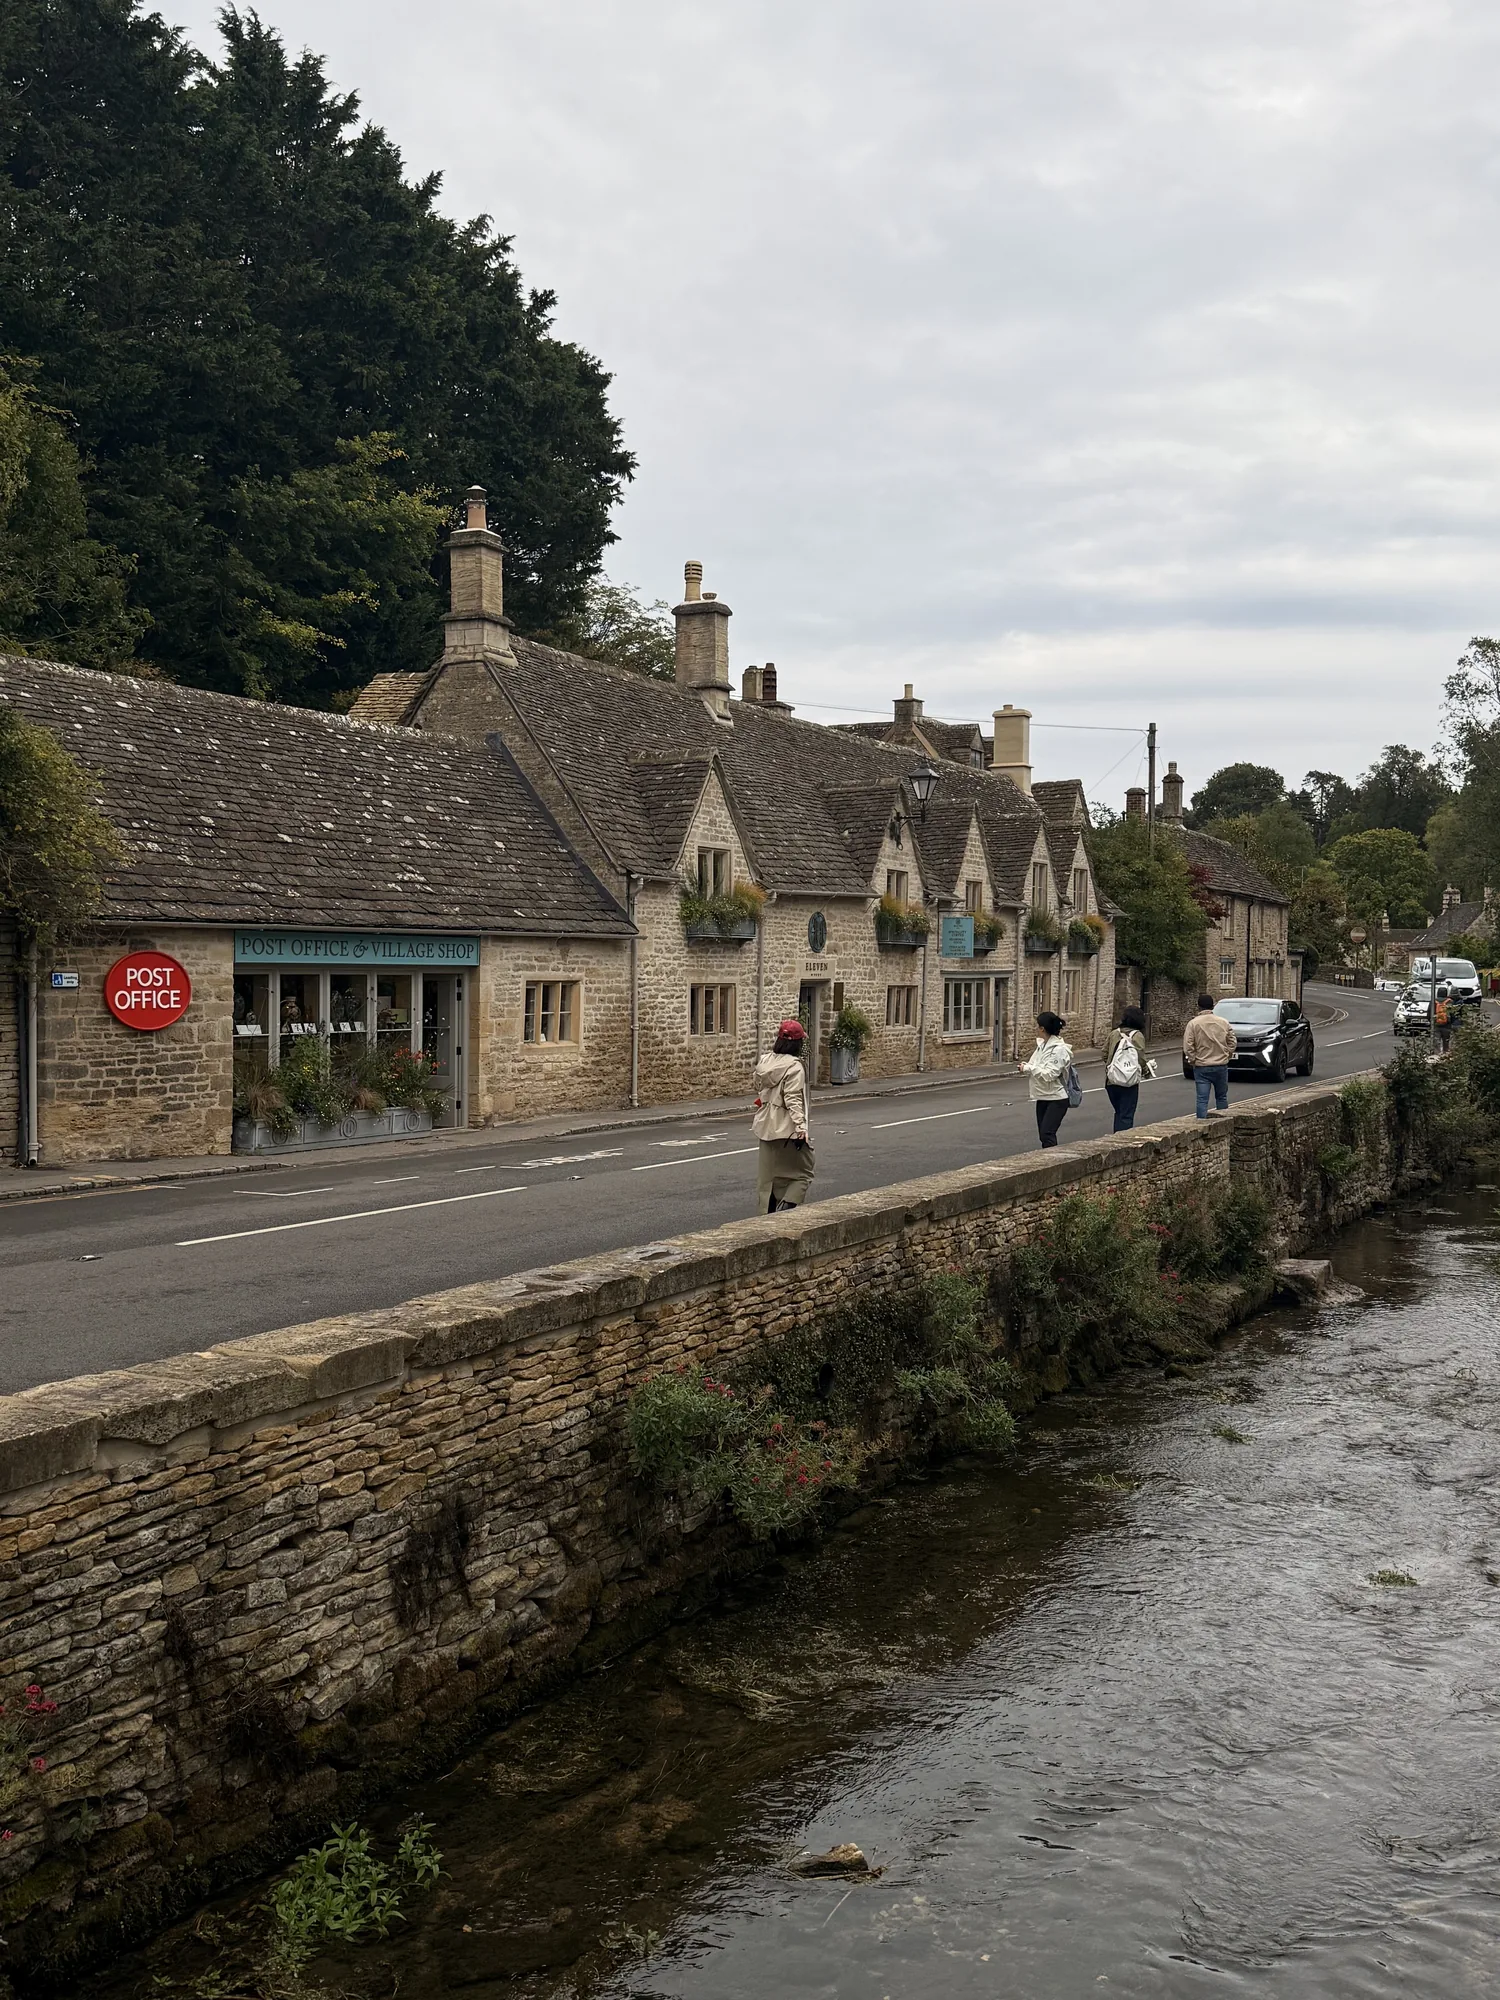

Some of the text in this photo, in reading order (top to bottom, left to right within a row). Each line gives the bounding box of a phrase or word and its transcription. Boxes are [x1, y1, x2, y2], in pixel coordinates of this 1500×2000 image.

[241, 937, 474, 959] POST OFFICE & VILLAGE SHOP
[126, 967, 175, 987] POST
[805, 962, 829, 972] ELEVEN
[114, 989, 182, 1010] OFFICE
